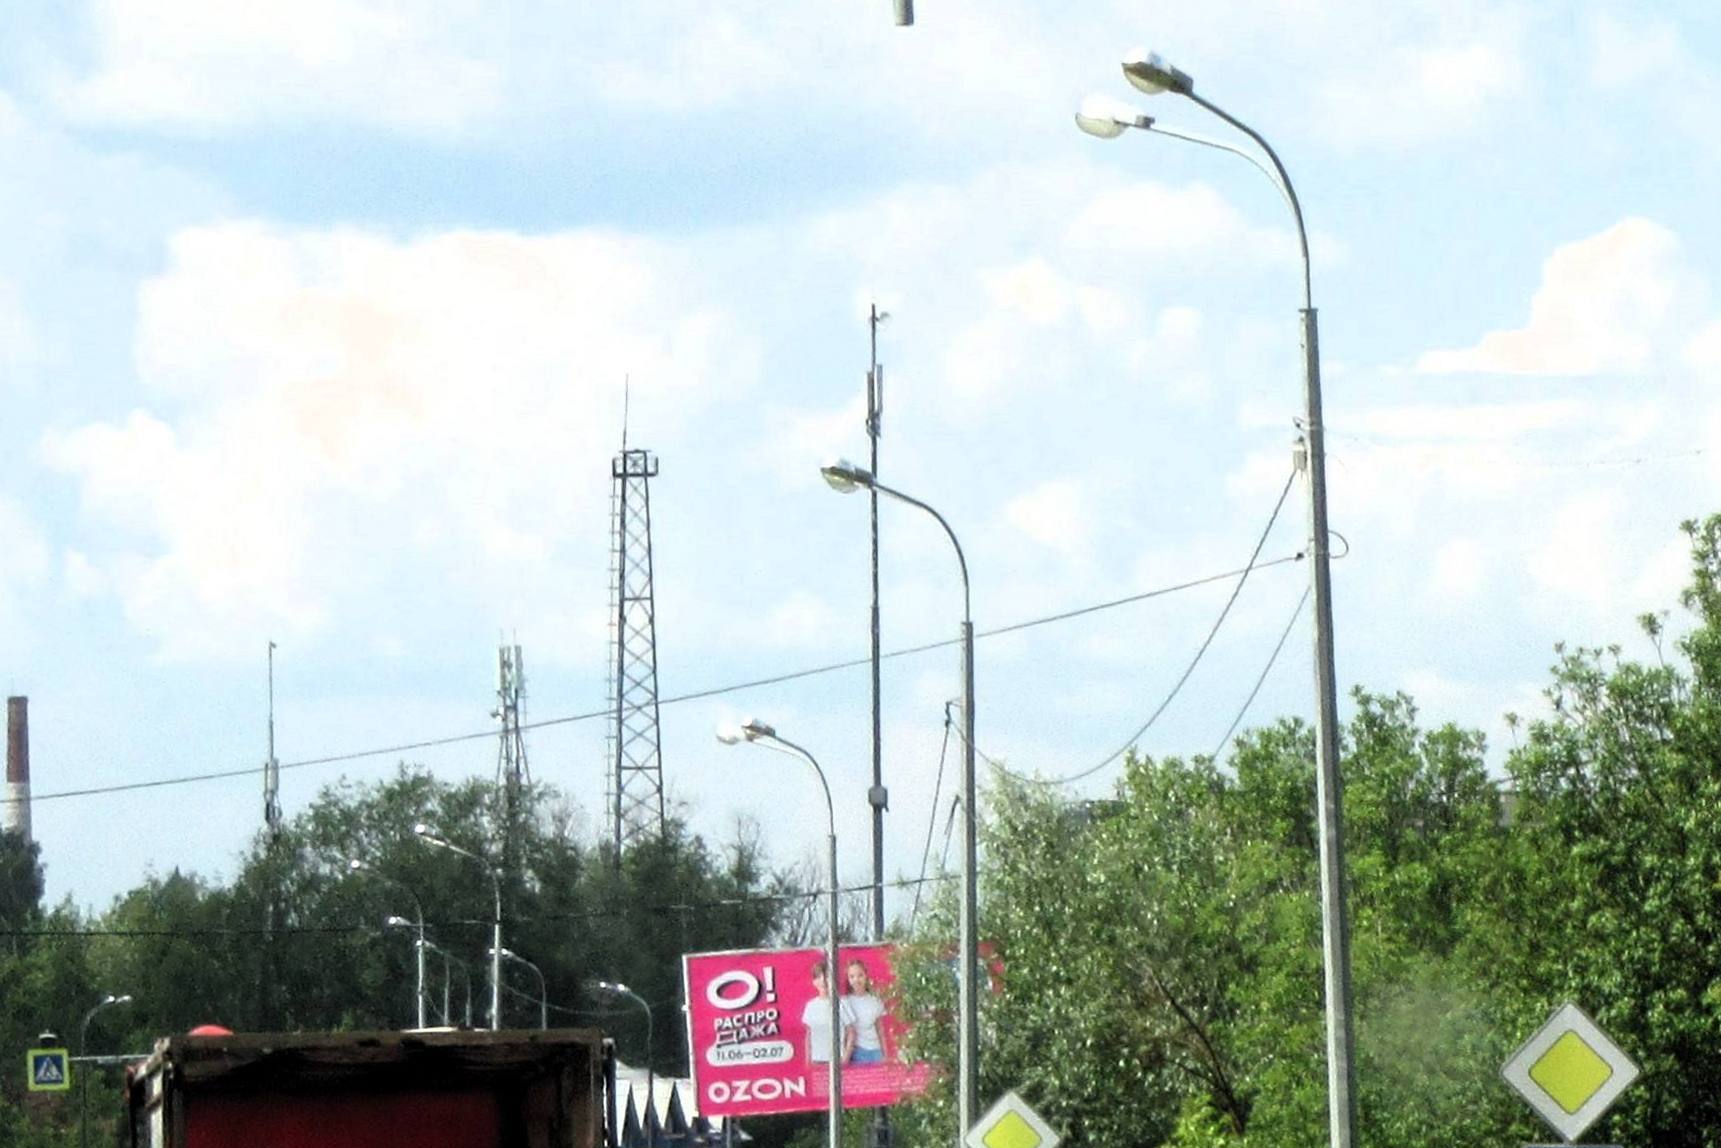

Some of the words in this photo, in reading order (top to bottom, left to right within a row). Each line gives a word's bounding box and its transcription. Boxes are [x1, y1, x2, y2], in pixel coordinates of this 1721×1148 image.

[714, 1007, 779, 1031] РАСПРО
[716, 1022, 779, 1048] ДАЖА
[707, 1076, 806, 1104] OZON
